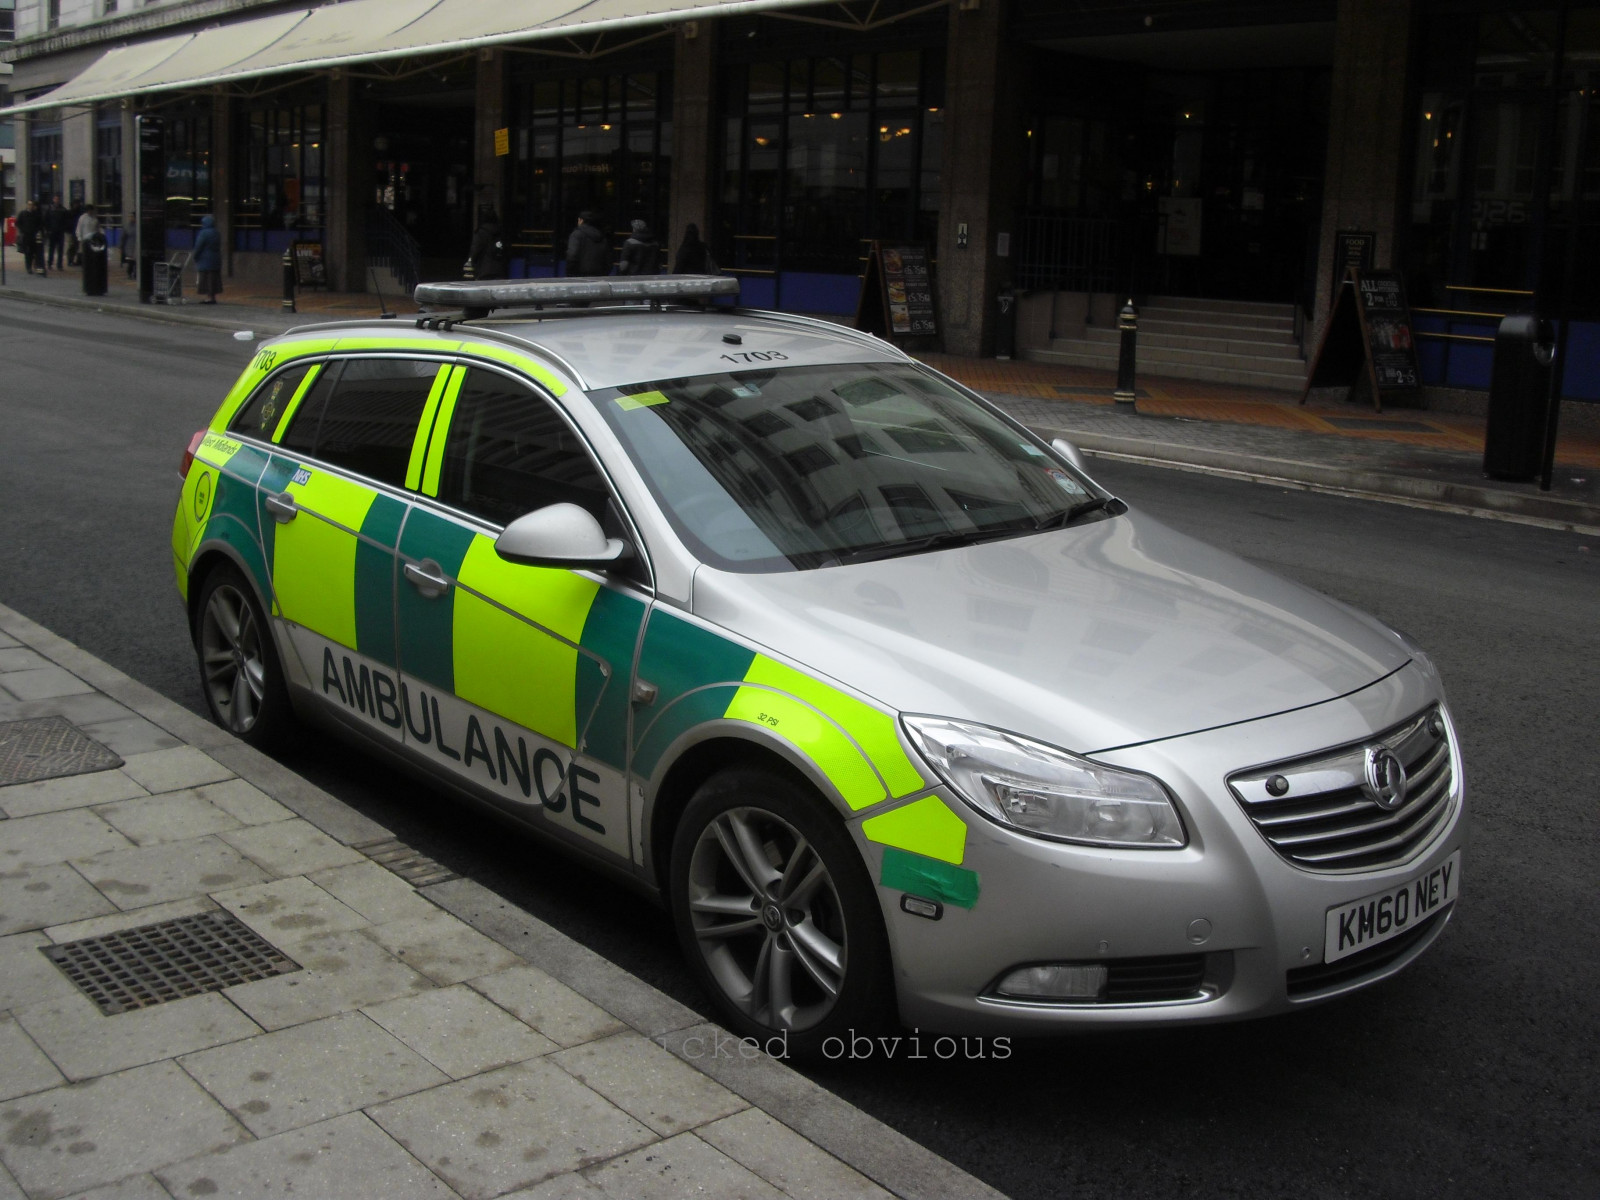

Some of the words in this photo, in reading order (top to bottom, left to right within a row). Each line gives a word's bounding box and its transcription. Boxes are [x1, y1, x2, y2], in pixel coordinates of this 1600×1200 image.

[1360, 279, 1379, 292] ALL
[1366, 292, 1375, 306] 2
[253, 349, 277, 371] 1703
[719, 350, 789, 364] 1703
[292, 468, 311, 485] NHS
[757, 712, 768, 722] 32
[766, 716, 780, 726] PSI
[322, 646, 606, 835] AMBULANCE
[1338, 887, 1409, 952] KM60
[1415, 861, 1453, 918] NEY
